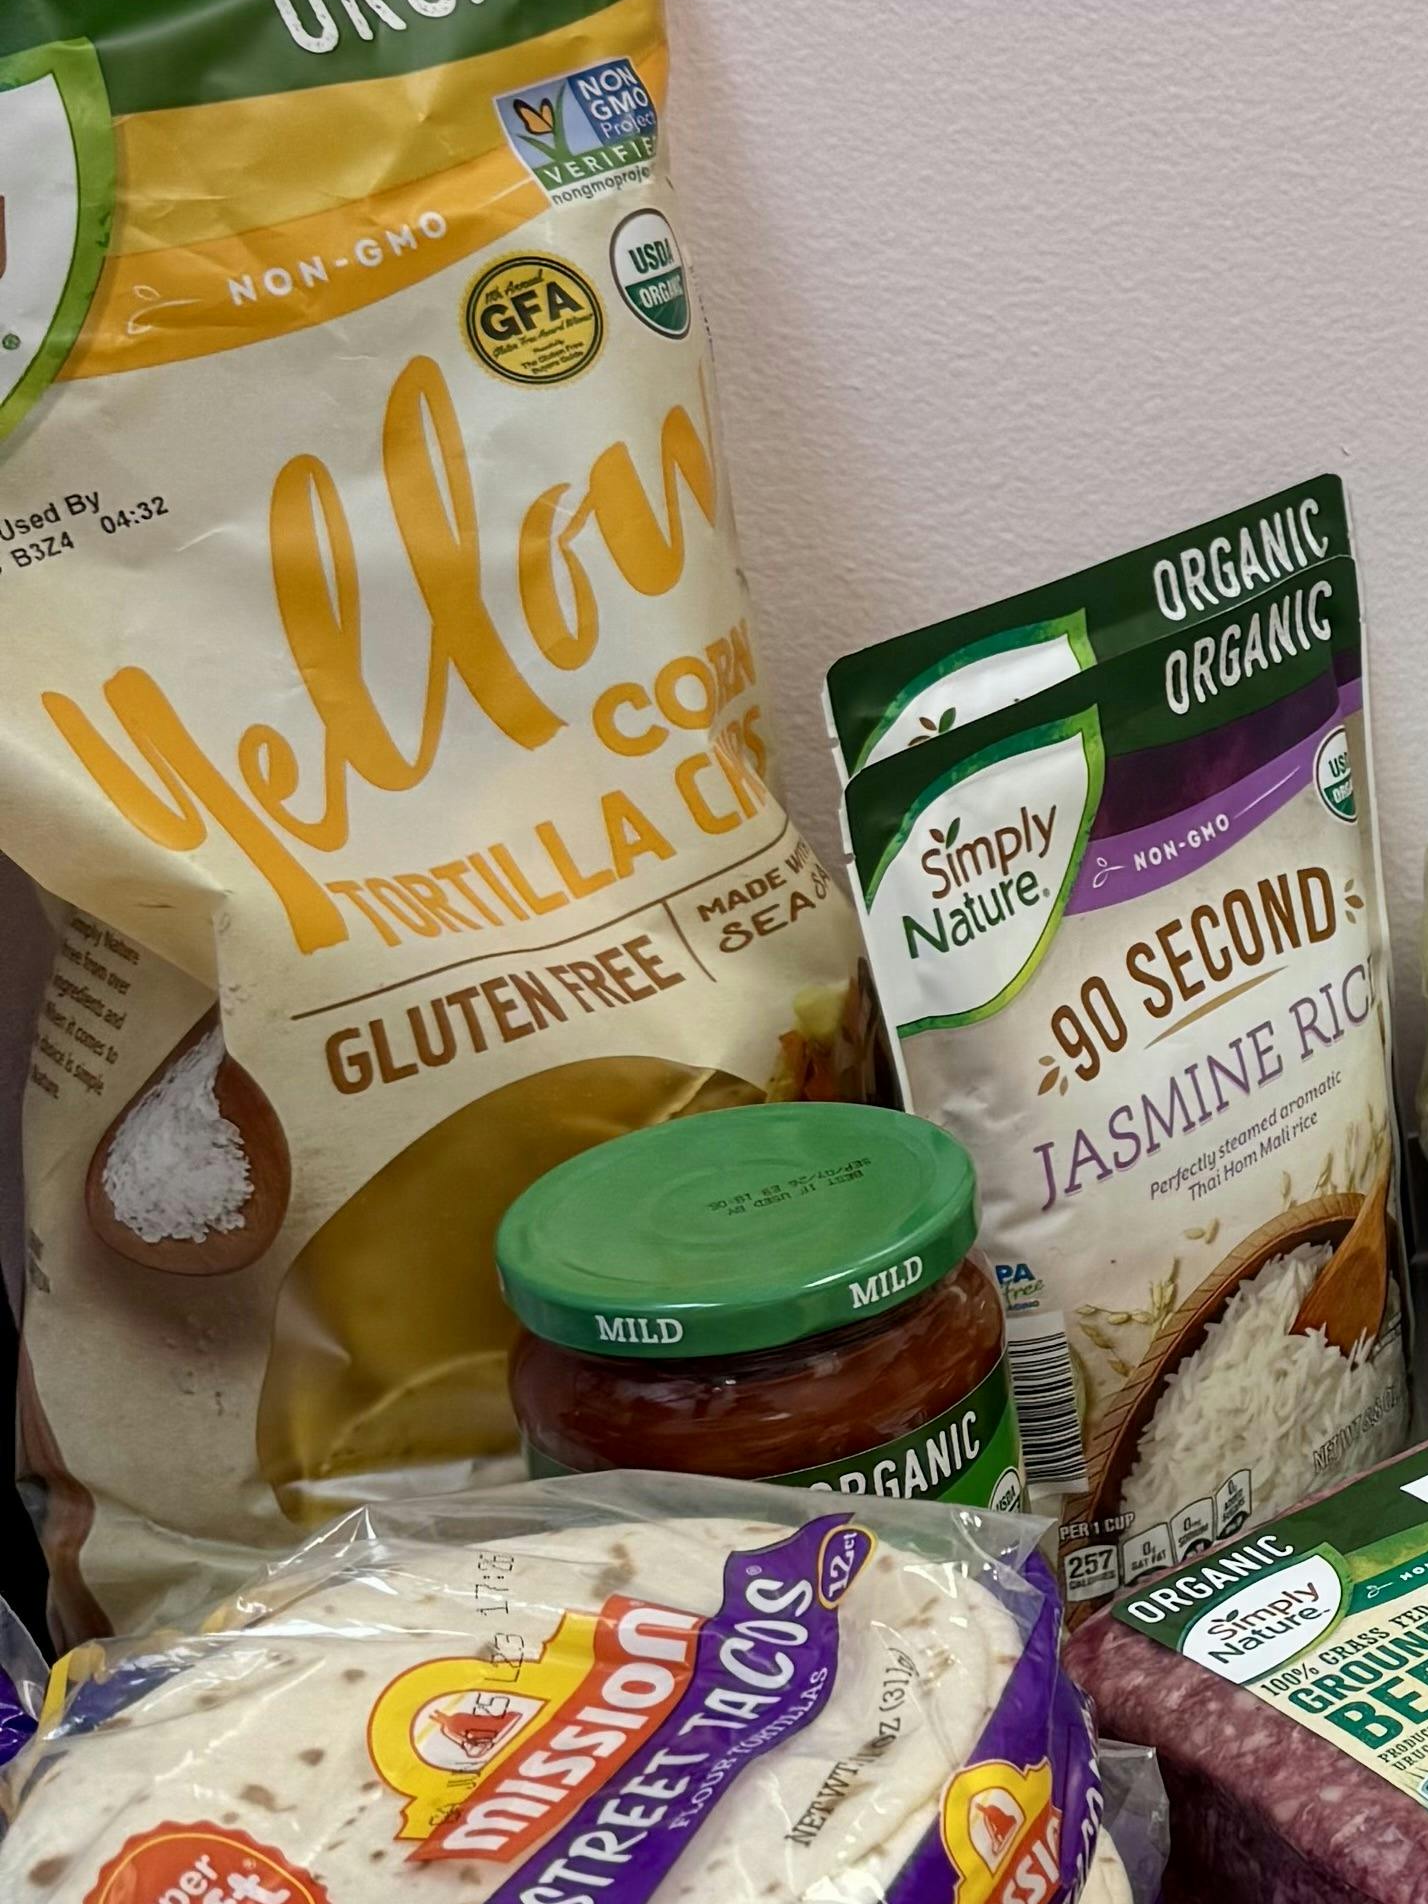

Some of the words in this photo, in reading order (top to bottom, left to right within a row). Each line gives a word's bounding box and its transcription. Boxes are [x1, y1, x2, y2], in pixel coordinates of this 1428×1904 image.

[578, 66, 633, 98] NON
[591, 84, 648, 122] GMO
[229, 211, 448, 308] NON-GMO
[479, 284, 574, 342] GFA
[100, 495, 169, 535] 04:32
[1153, 498, 1330, 622] ORGANIC
[1163, 581, 1334, 716] ORGANIC
[326, 789, 677, 953] TORTILLA
[921, 804, 1058, 898] Simply
[1134, 813, 1230, 872] NON-GMO
[326, 966, 566, 1094] GLUTEN
[569, 934, 685, 1021] FREE
[1051, 976, 1128, 1082] 90
[1126, 867, 1335, 1018] SECOND
[1033, 1020, 1283, 1212] JASMINE
[1151, 1152, 1216, 1199] Perfectly
[1219, 1109, 1277, 1154] steamed
[1279, 1070, 1342, 1121] aromatic
[1189, 1171, 1221, 1200] Thai
[1224, 1153, 1258, 1177] Hom
[1261, 1130, 1291, 1157] Mali
[1292, 1111, 1318, 1136] rice
[851, 1255, 922, 1309] MILD
[595, 1316, 684, 1345] MILD
[1128, 1535, 1294, 1624] ORGANIC
[681, 1577, 814, 1748] TACOS
